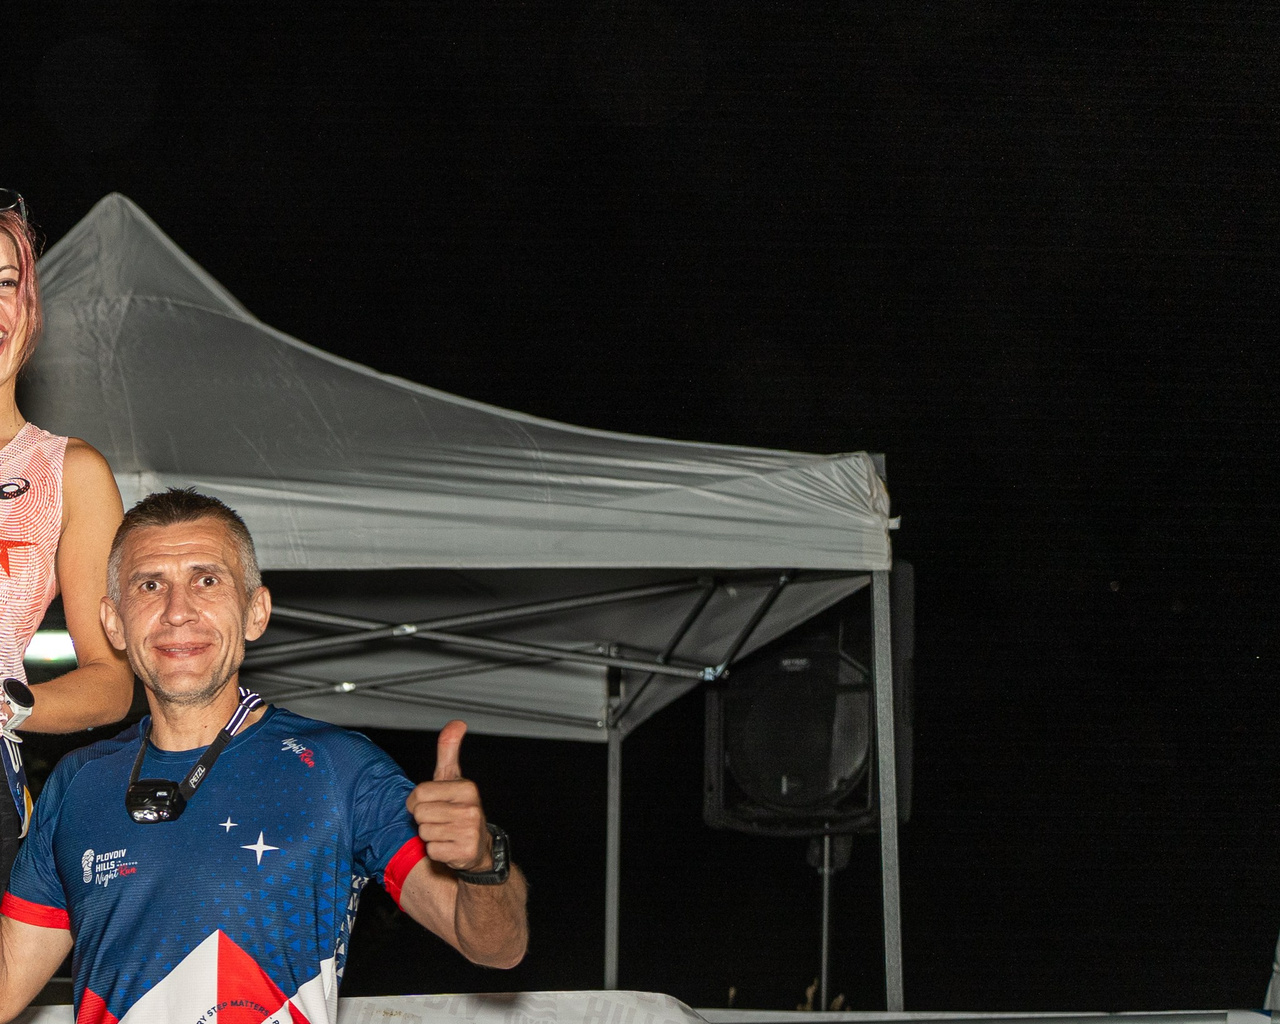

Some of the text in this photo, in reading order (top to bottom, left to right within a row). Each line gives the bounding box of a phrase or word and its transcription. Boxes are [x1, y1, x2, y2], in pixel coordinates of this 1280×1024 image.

[189, 767, 206, 789] PETZL
[95, 849, 127, 863] PLOVDIV
[95, 861, 116, 873] HILLS
[95, 868, 119, 888] Night
[206, 1002, 227, 1017] STEP
[230, 1000, 269, 1017] MATTERS
